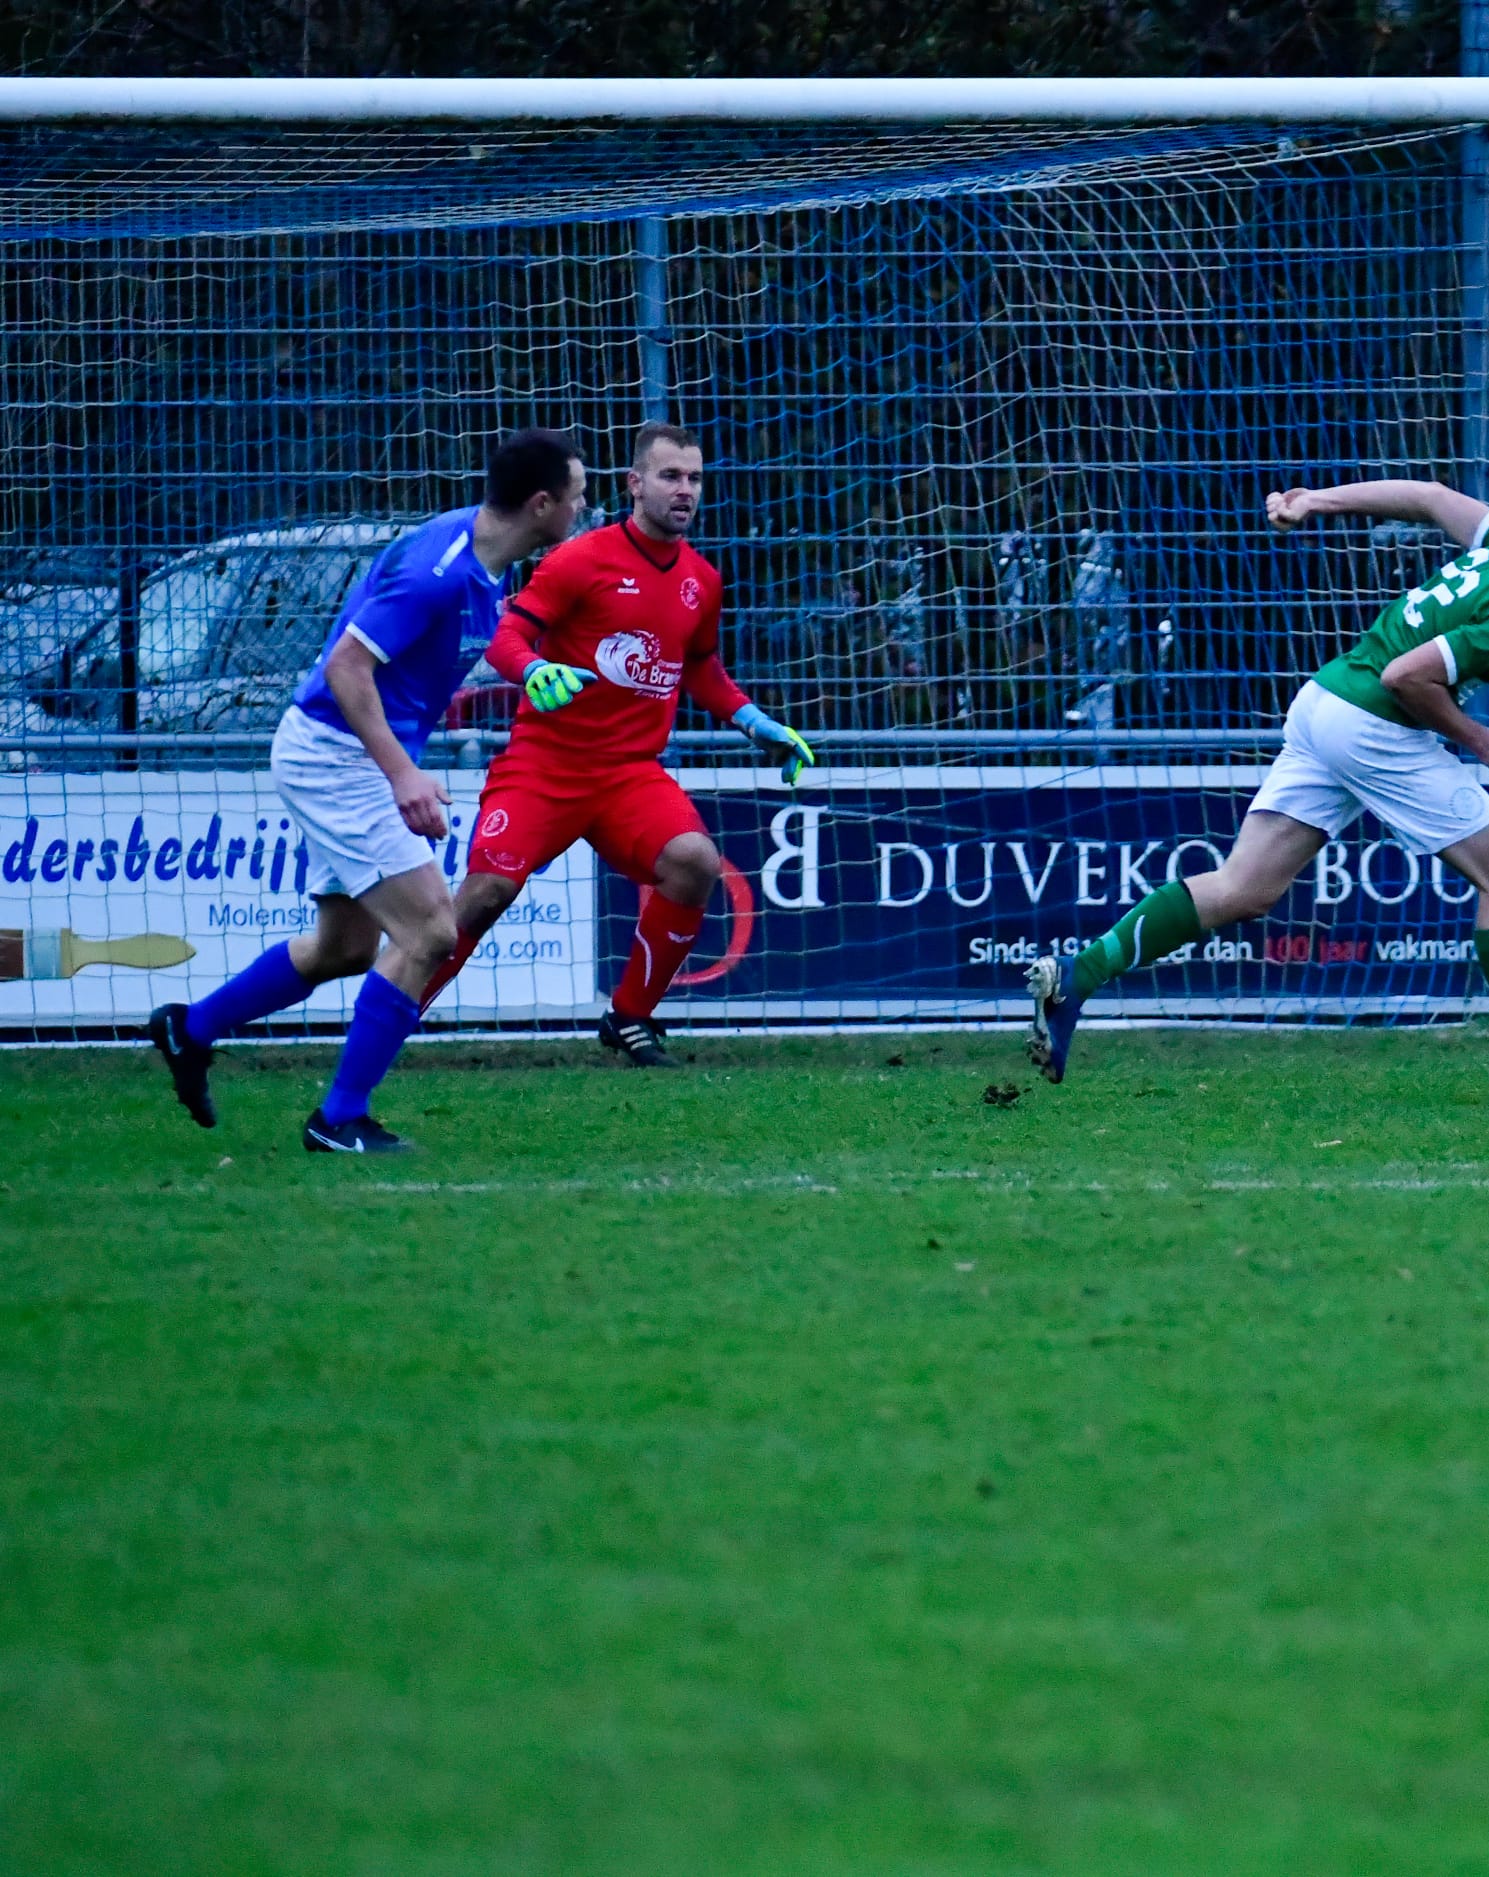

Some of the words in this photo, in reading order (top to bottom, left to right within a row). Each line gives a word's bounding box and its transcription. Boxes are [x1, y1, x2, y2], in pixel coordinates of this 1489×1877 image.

[0, 811, 310, 896] dersbedrijf
[501, 899, 561, 922] erke
[968, 936, 1039, 965] Sinds
[1203, 935, 1252, 963] dan
[1265, 936, 1310, 962] 100
[1320, 937, 1367, 966] jaar
